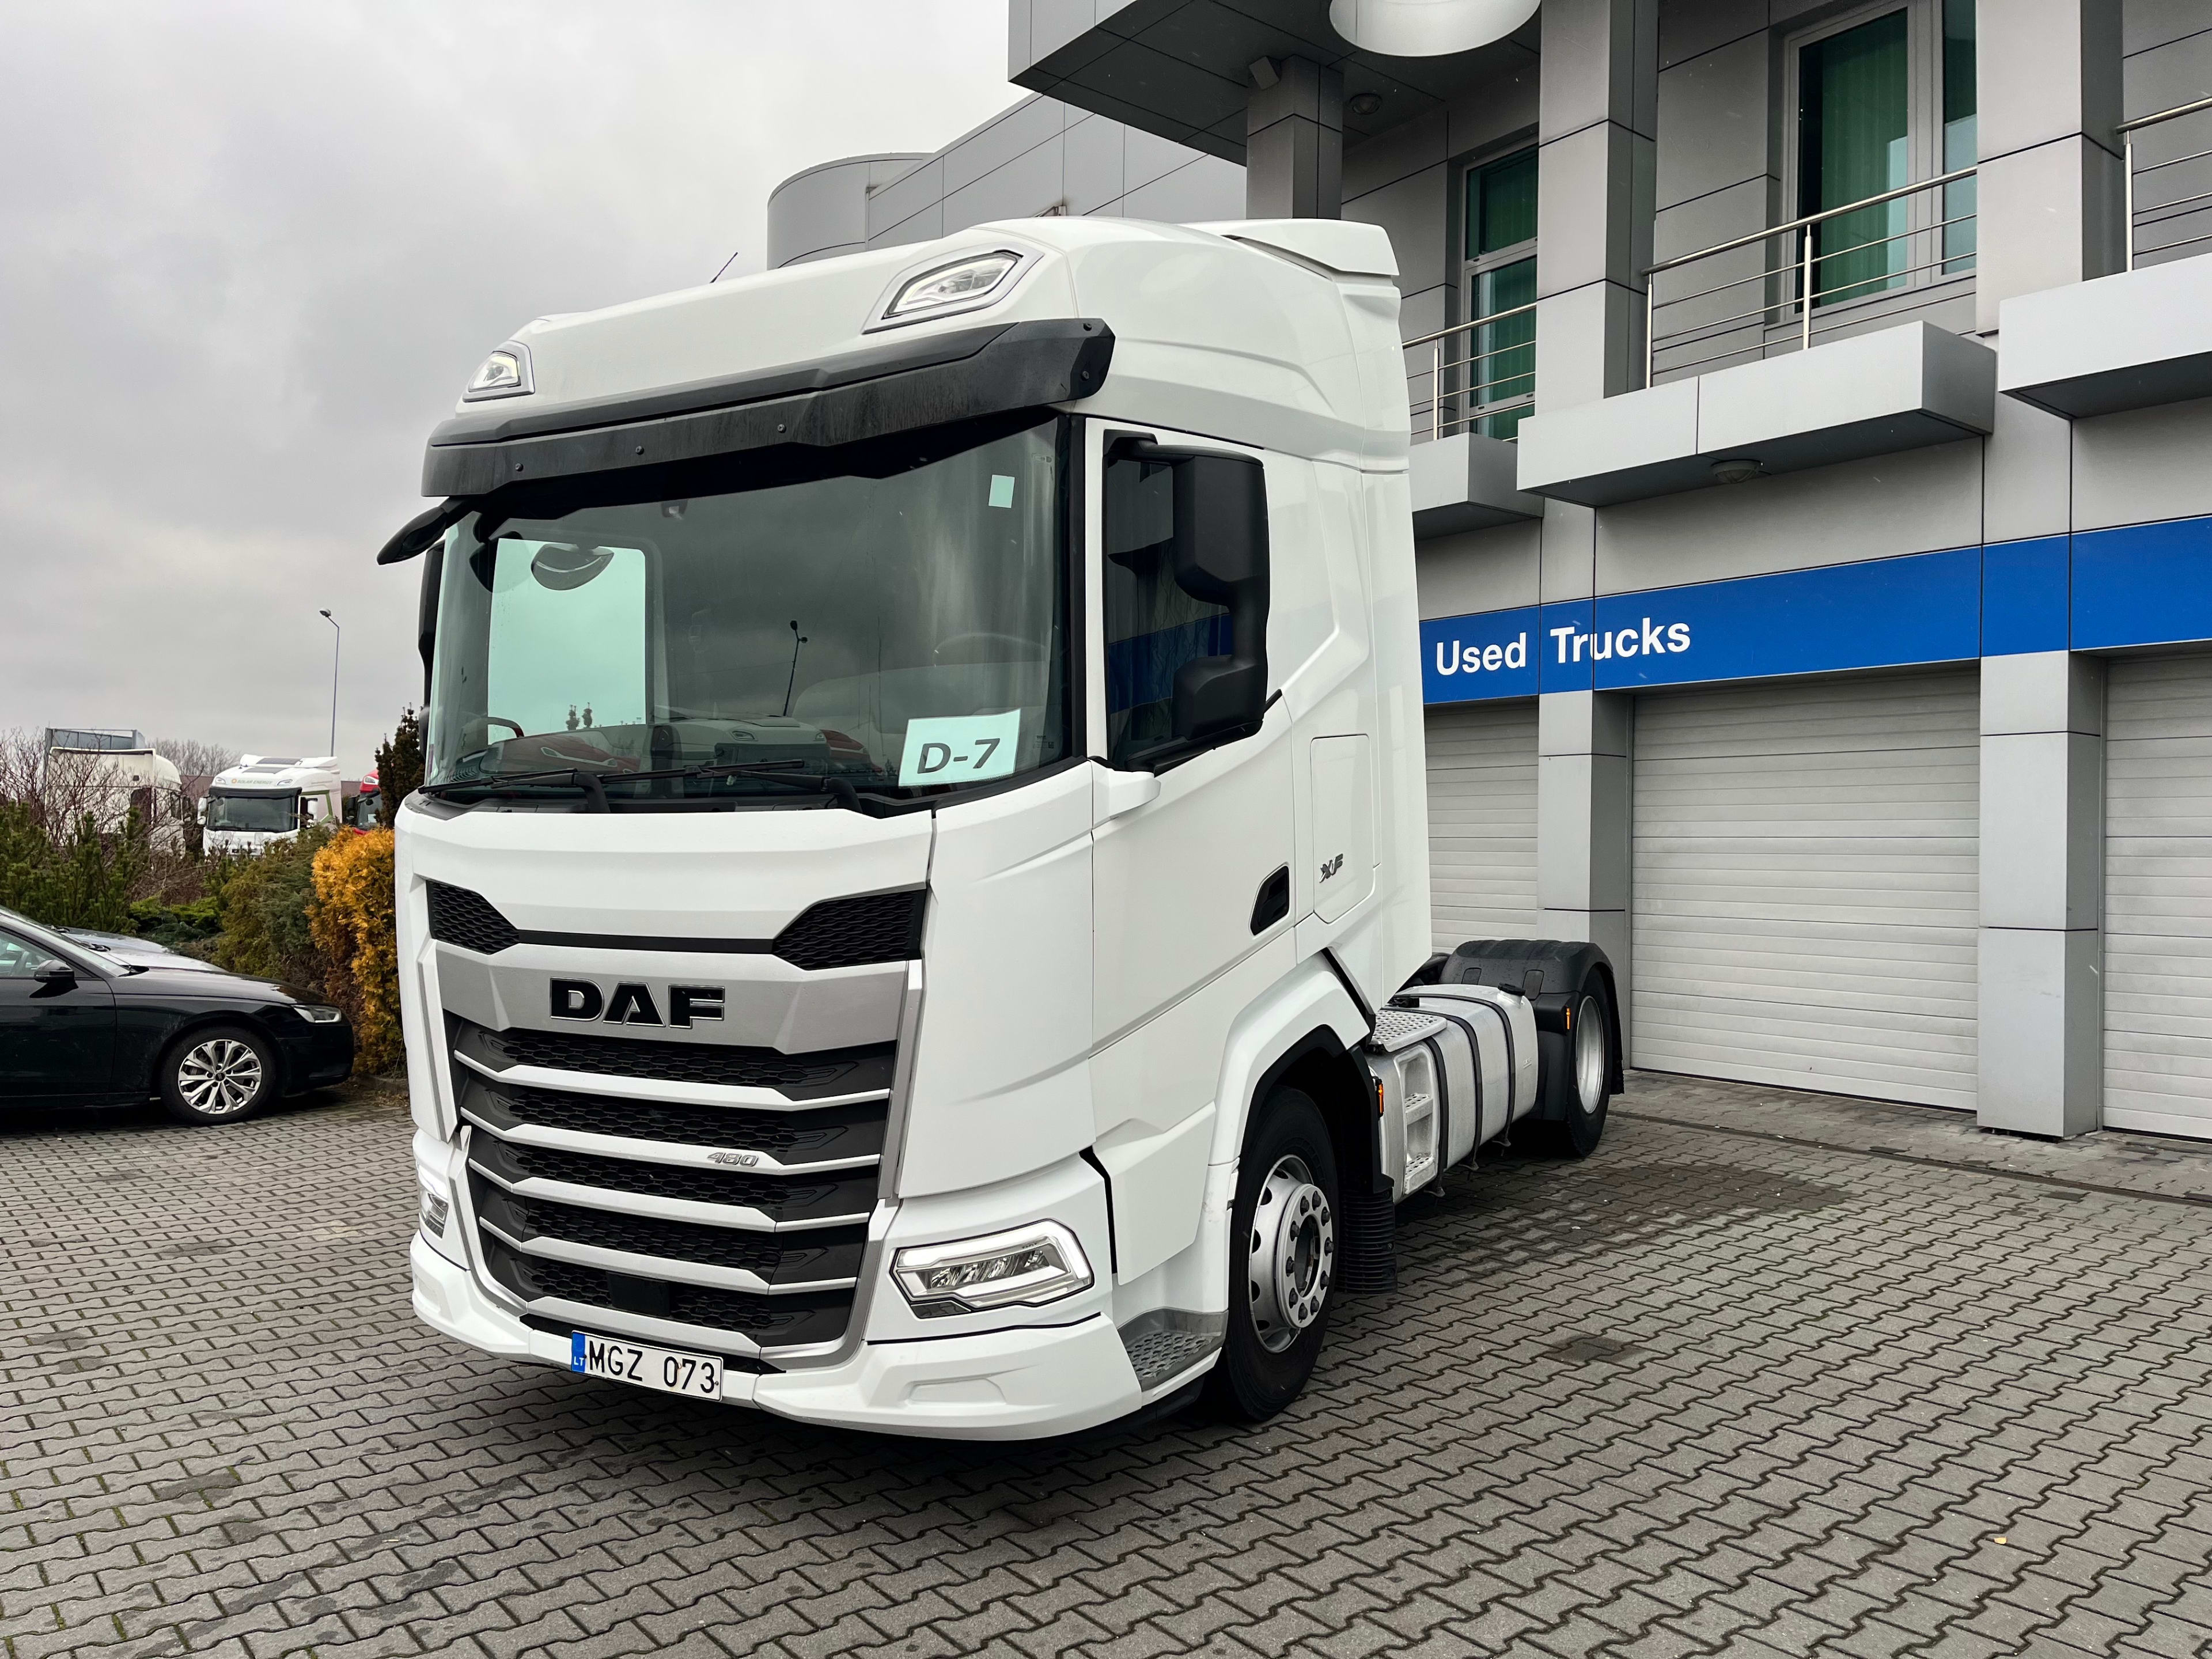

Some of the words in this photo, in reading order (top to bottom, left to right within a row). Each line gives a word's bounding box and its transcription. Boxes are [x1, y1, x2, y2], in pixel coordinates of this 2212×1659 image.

[1436, 632, 1527, 676] Used
[1550, 617, 1691, 664] Trucks
[916, 737, 1001, 774] D-7
[1319, 853, 1343, 884] XF
[550, 976, 725, 1029] DAF
[707, 1152, 759, 1167] 480
[573, 1356, 584, 1368] LT
[589, 1340, 643, 1382] MGZ
[664, 1356, 715, 1393] 073
